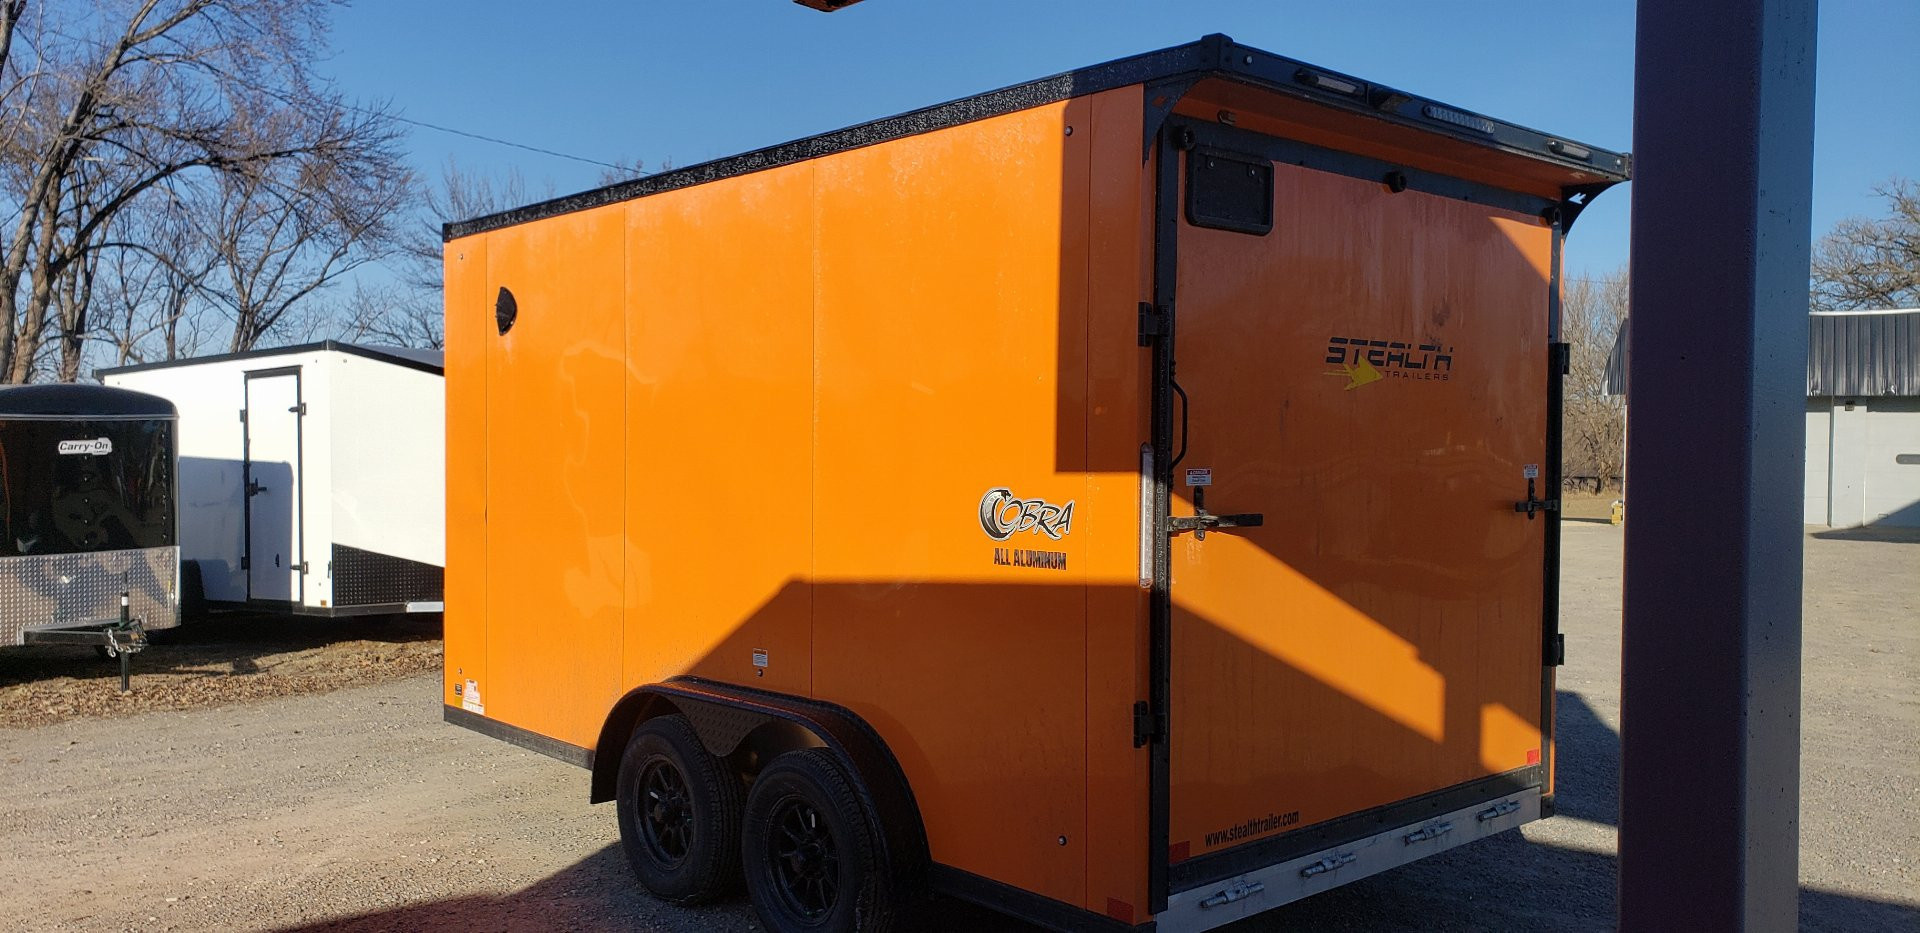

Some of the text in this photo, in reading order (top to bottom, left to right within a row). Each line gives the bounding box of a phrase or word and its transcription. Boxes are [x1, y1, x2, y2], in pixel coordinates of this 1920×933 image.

[1325, 337, 1453, 370] STEALTH
[1385, 370, 1449, 380] TRAILERS
[60, 442, 108, 452] Carry-On
[979, 487, 1075, 541] COBRA
[993, 547, 1067, 571] ALL ALUMINUM
[1204, 810, 1300, 847] www.stealthtrailer.com
